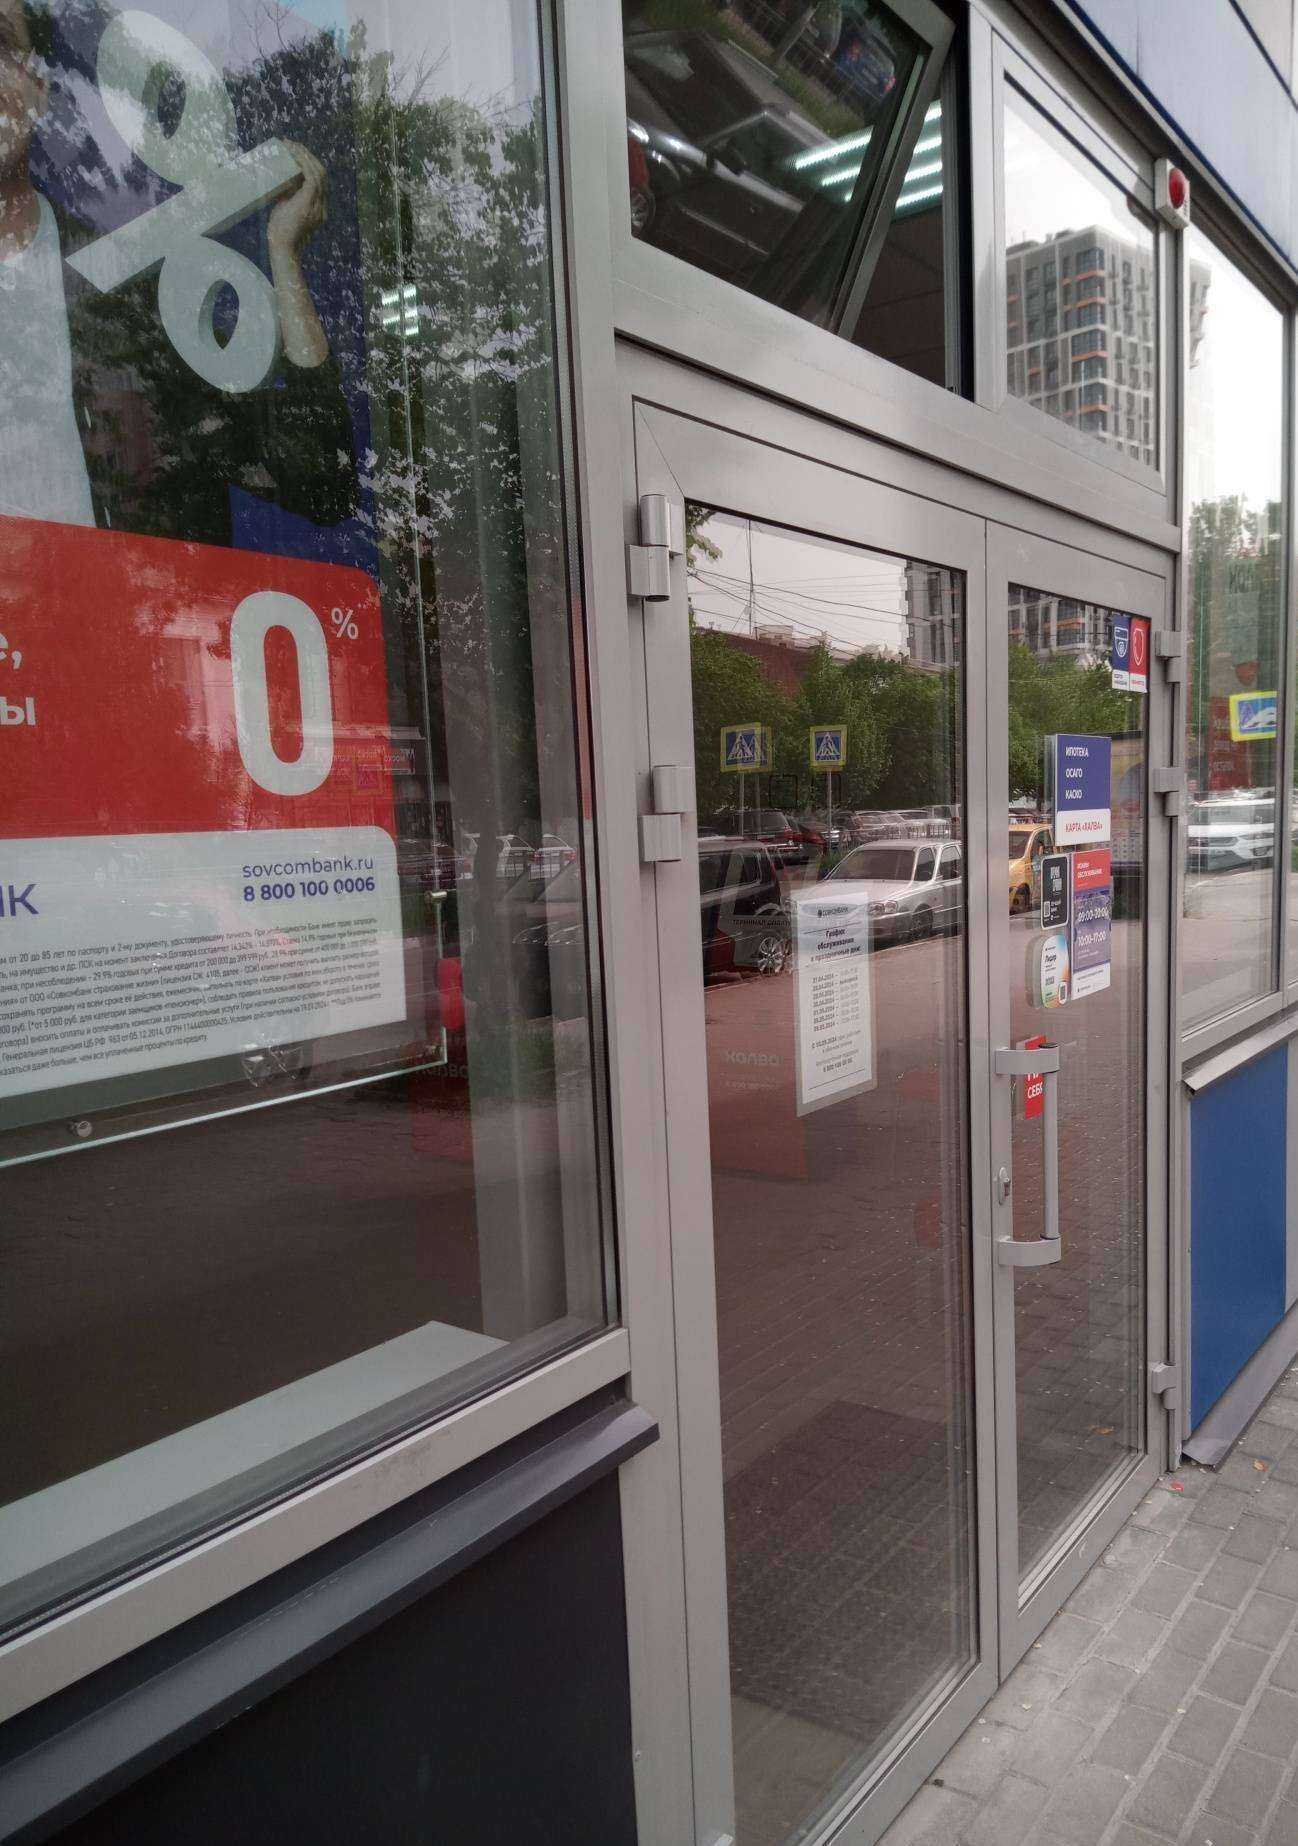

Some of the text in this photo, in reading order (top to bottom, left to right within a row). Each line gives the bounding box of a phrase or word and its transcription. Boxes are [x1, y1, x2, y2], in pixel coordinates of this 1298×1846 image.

[230, 591, 358, 796] 0 %
[1066, 747, 1088, 757] ИПОТЕКА
[1066, 769, 1083, 778] ОСАГО
[1066, 790, 1083, 800] КАСКО
[1066, 822, 1081, 833] КАРТА
[242, 856, 373, 878] sovcombank.ru
[243, 877, 375, 901] 8 800 100 0006
